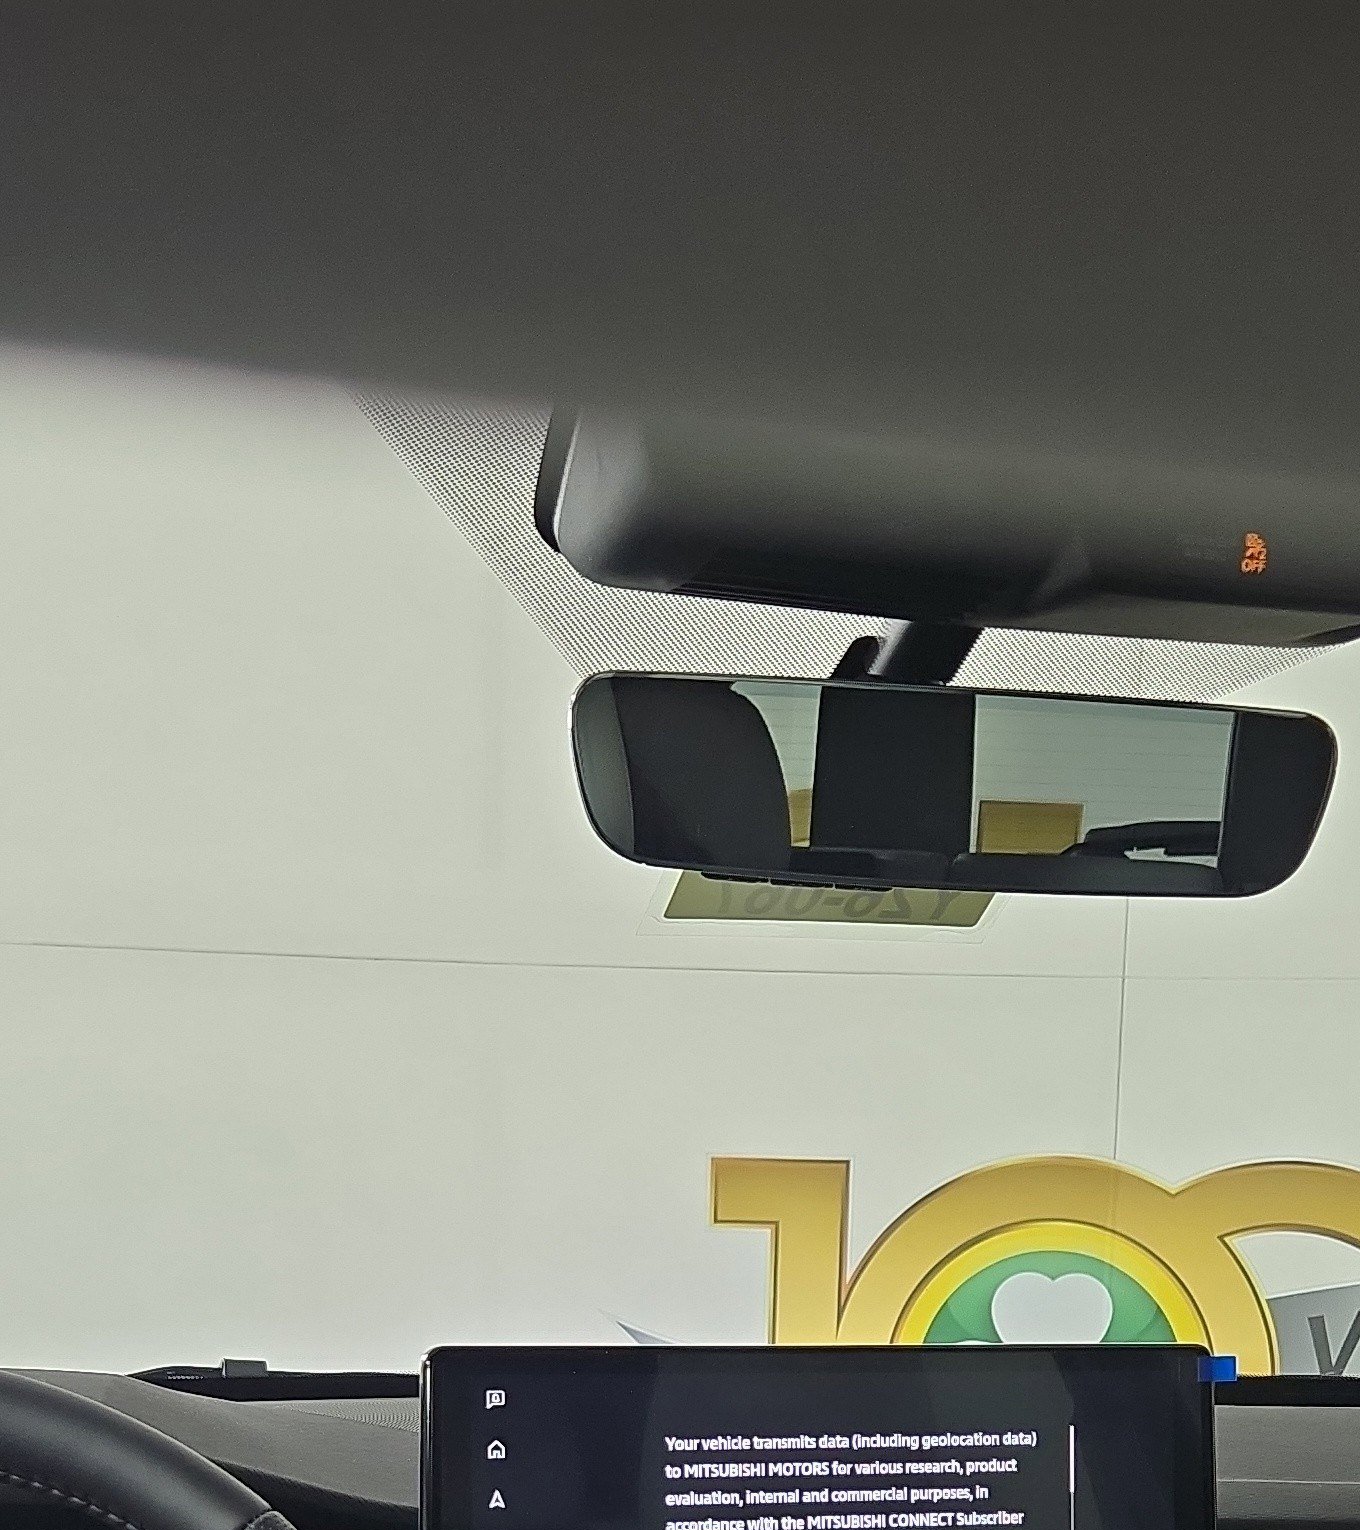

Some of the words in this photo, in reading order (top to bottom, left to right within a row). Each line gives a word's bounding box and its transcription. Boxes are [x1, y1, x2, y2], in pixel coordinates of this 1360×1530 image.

[665, 1436, 700, 1451] Your
[701, 1435, 751, 1450] vehicle
[752, 1434, 817, 1449] transmits
[818, 1434, 850, 1449] data
[852, 1433, 920, 1450] (including
[921, 1432, 1000, 1450] geolocation
[1002, 1431, 1038, 1447] data)
[665, 1464, 682, 1478] to
[684, 1462, 766, 1478] MITSUBISHI
[768, 1462, 830, 1477] MOTORS
[831, 1461, 853, 1476] for
[854, 1461, 904, 1475] various
[905, 1459, 964, 1475] research,
[965, 1458, 1018, 1476] product
[665, 1490, 744, 1507] evaluation,
[745, 1489, 800, 1504] internal
[801, 1488, 829, 1503] and
[830, 1486, 908, 1502] commercial
[910, 1486, 974, 1503] purposes,
[975, 1484, 989, 1499] in
[746, 1516, 779, 1530] with
[780, 1516, 805, 1530] the
[807, 1514, 887, 1530] MITSUBISHI
[889, 1512, 955, 1527] CONNECT
[956, 1511, 1025, 1526] Subscriber
